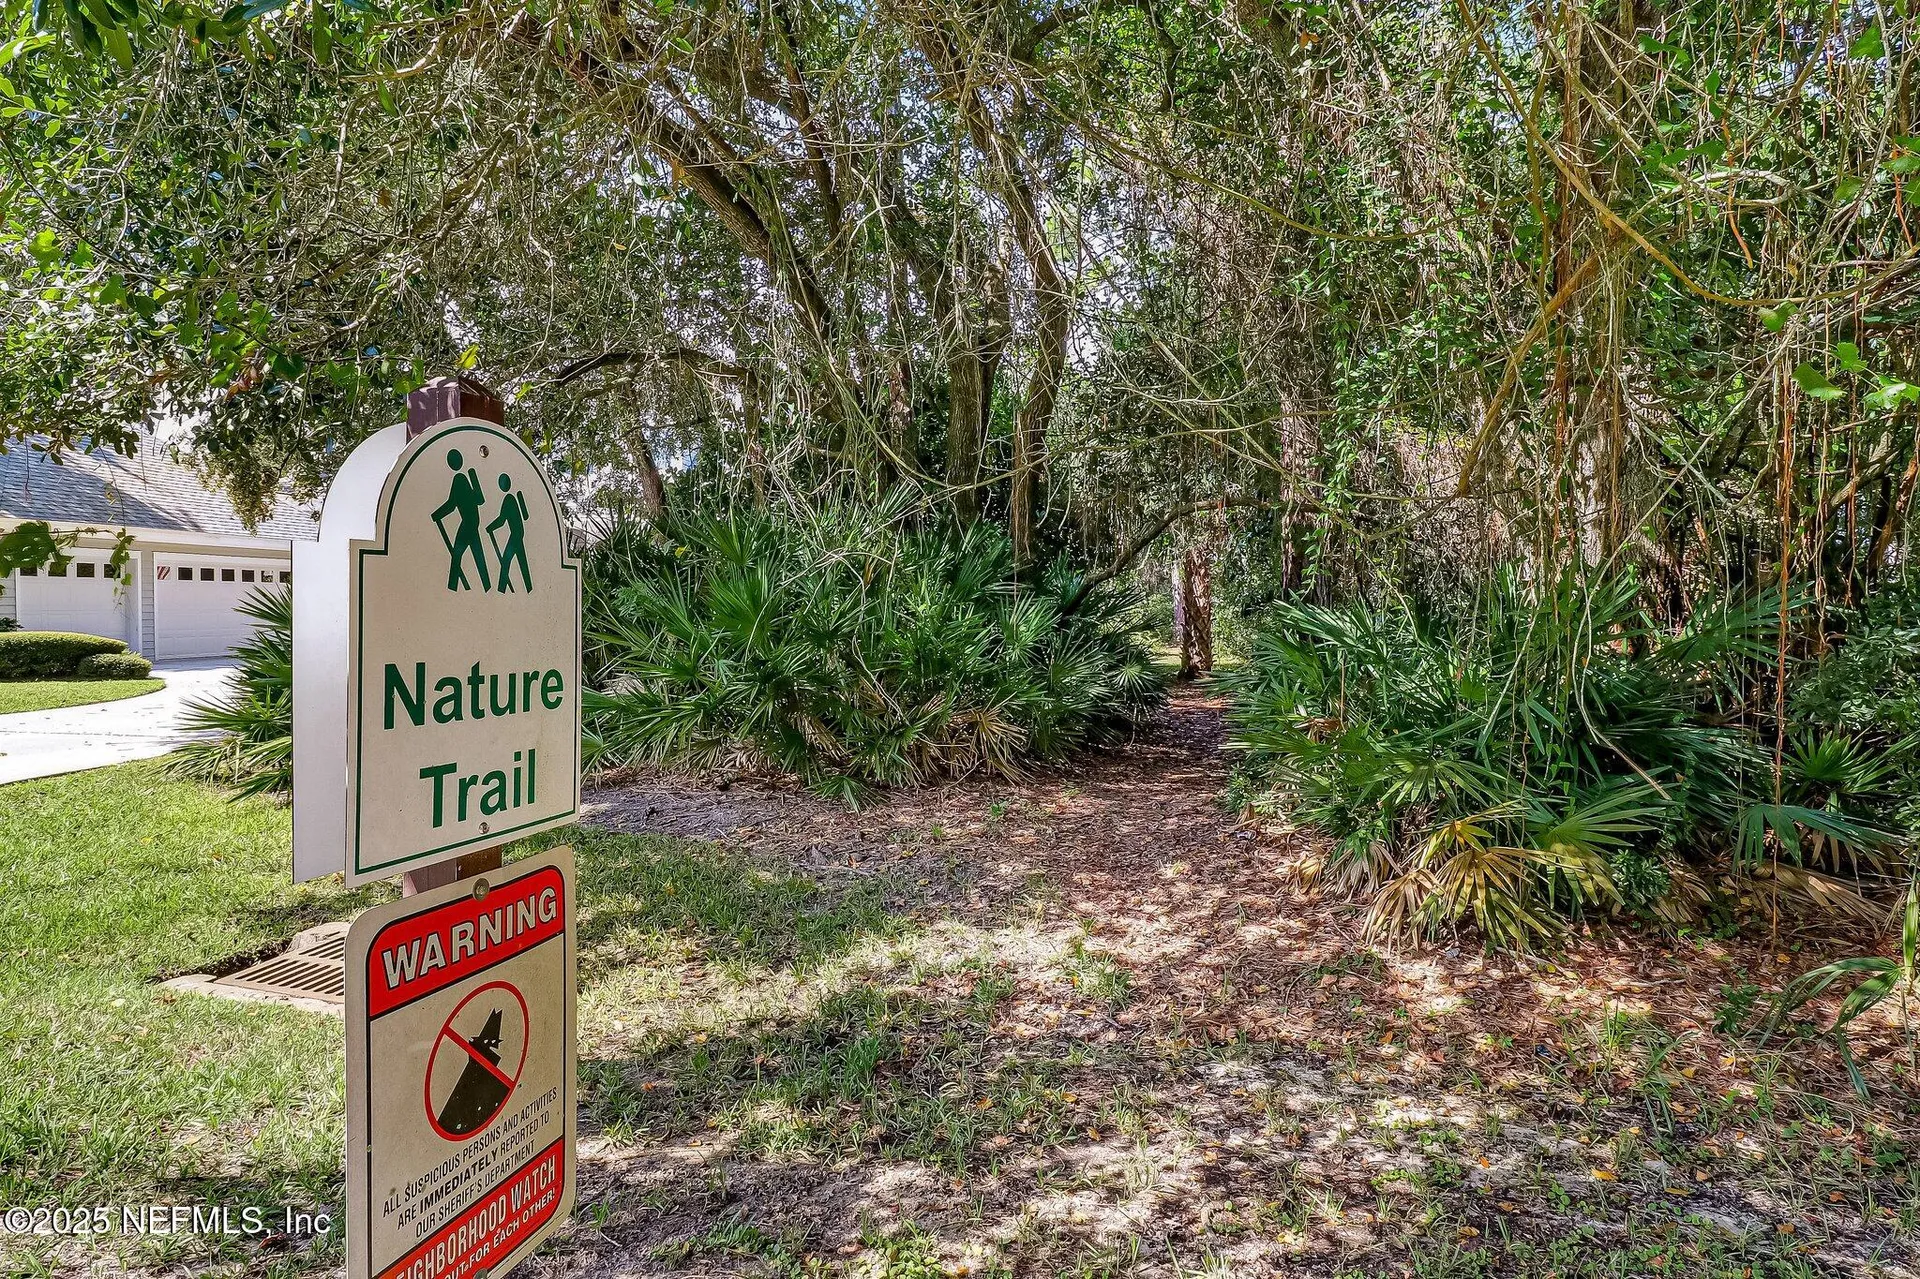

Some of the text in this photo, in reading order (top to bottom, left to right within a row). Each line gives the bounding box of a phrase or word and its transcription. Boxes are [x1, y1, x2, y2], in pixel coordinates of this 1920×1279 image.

[383, 660, 564, 731] Nature
[419, 748, 537, 829] Trail
[382, 887, 558, 990] WARNING
[383, 1086, 558, 1218] ALL SUSPICIOUS PERSONS AND ACTIVITIES
[397, 1110, 550, 1231] ARE IMMEDIATELY REPORTED TO
[415, 1138, 536, 1239] OUR SHERIFF'S DEPARTMENT
[510, 1154, 556, 1214] WATCH
[468, 1242, 491, 1269] FOR
[493, 1217, 520, 1249] EACH
[522, 1187, 556, 1224] OTHER!
